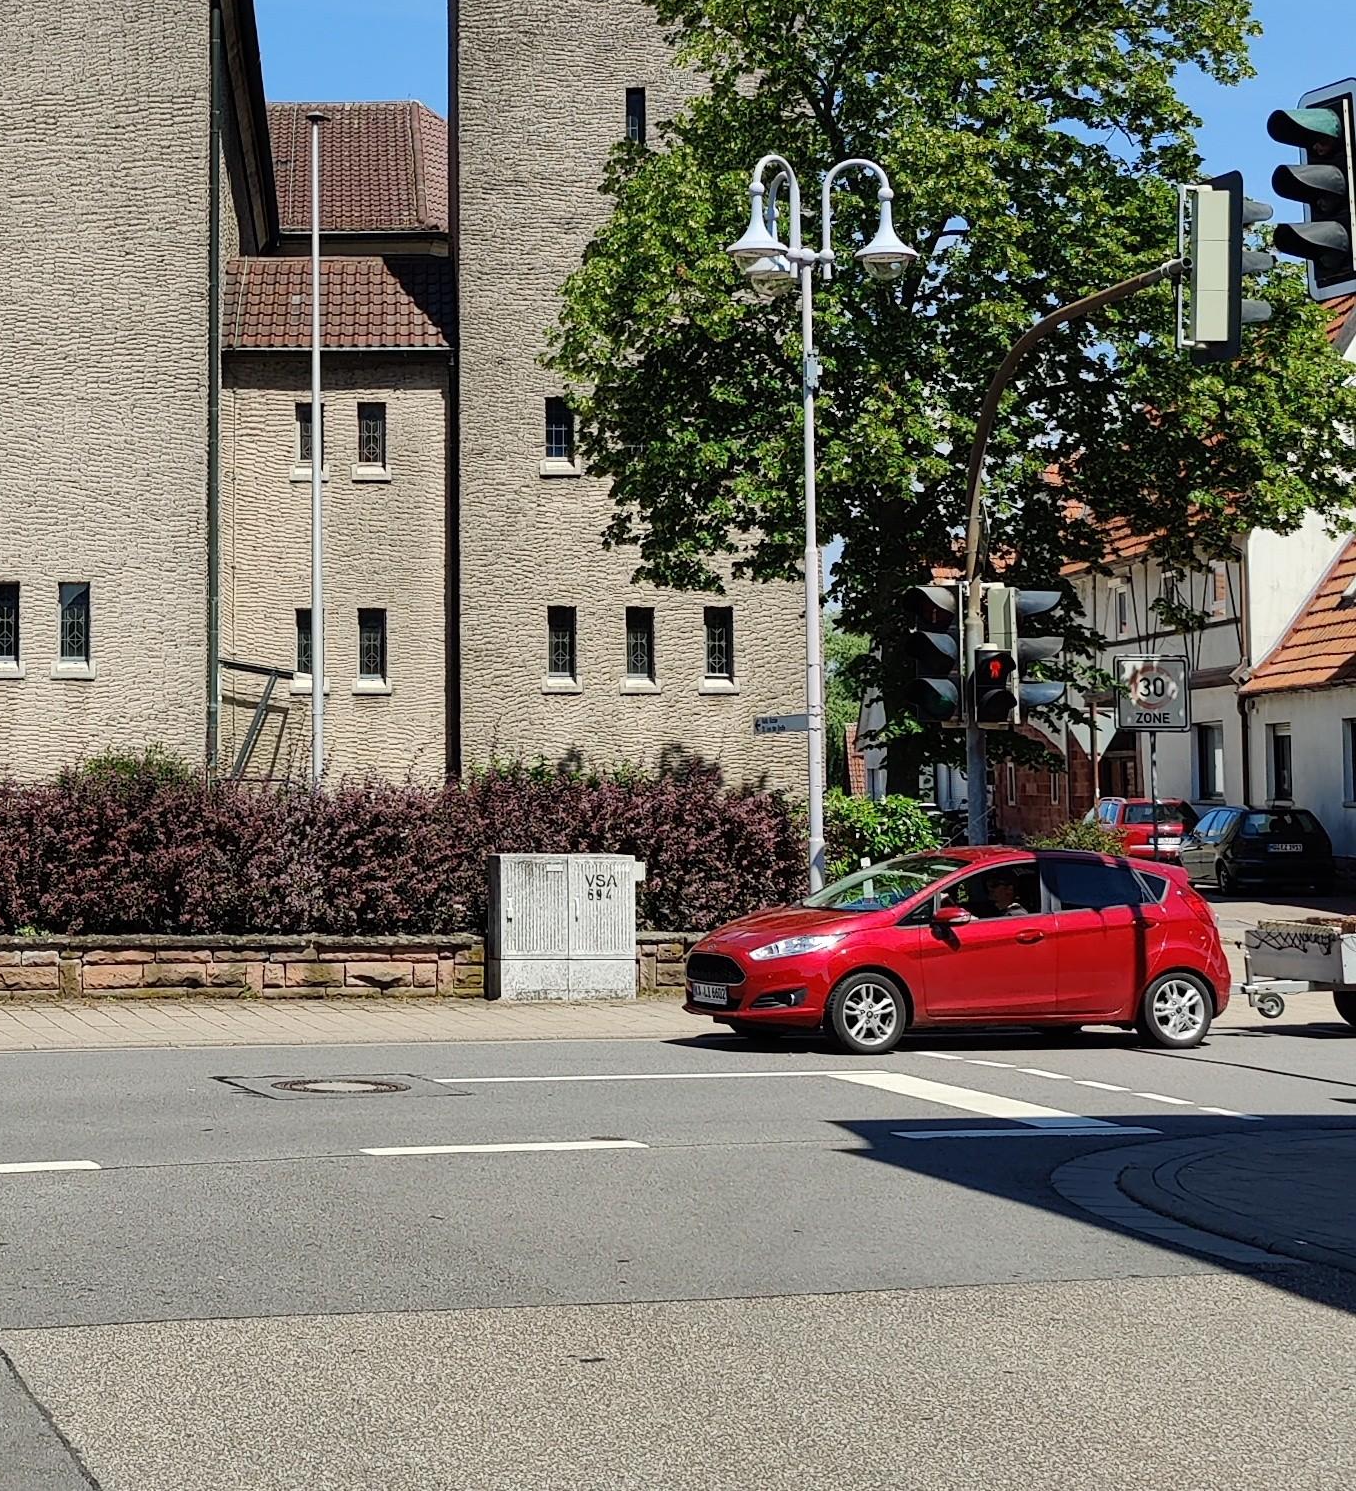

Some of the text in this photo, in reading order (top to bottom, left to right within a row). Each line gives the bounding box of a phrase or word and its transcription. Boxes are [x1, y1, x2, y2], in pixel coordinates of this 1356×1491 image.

[1139, 677, 1165, 698] 30
[1135, 712, 1171, 724] ZONE
[585, 874, 618, 888] VSA
[587, 889, 612, 901] 694
